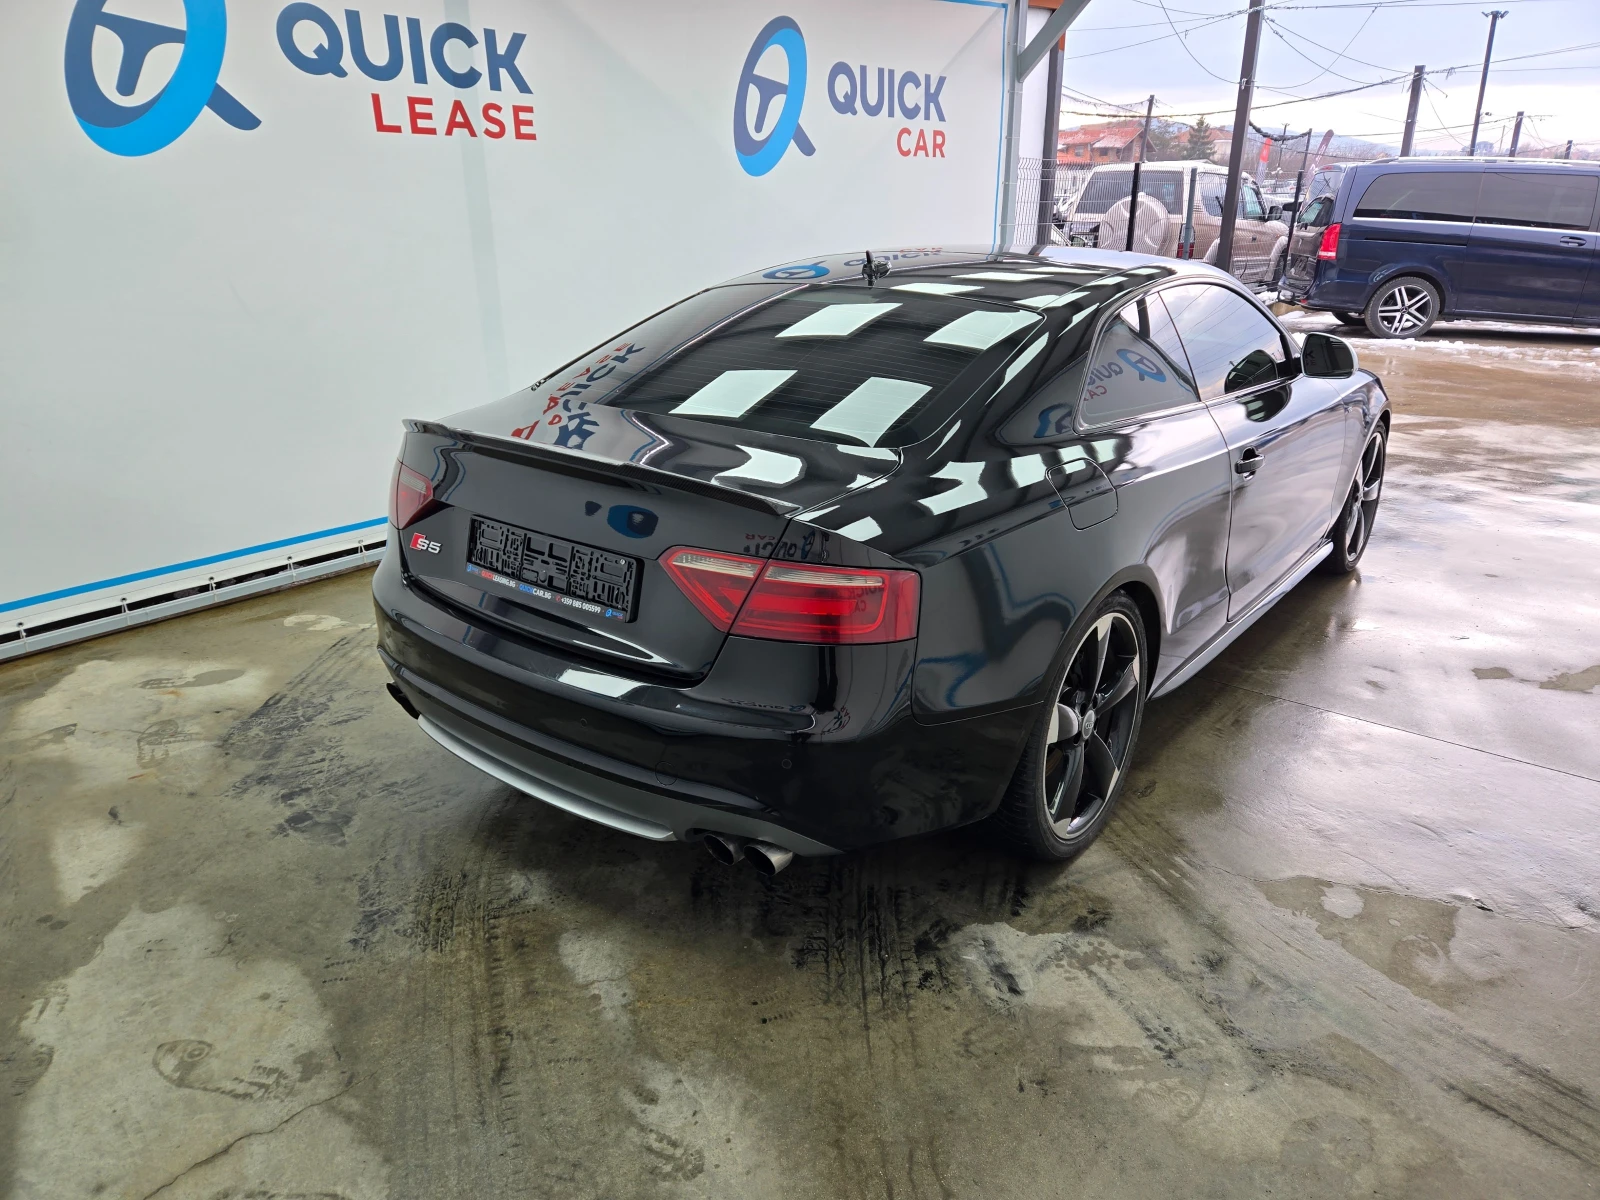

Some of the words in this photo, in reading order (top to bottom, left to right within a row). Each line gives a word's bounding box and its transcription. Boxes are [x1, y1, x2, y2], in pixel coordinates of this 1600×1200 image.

[276, 1, 534, 95] QUICK
[827, 61, 947, 122] QUICK
[370, 92, 537, 141] LEASE
[896, 127, 947, 158] CAR
[416, 537, 442, 554] S5
